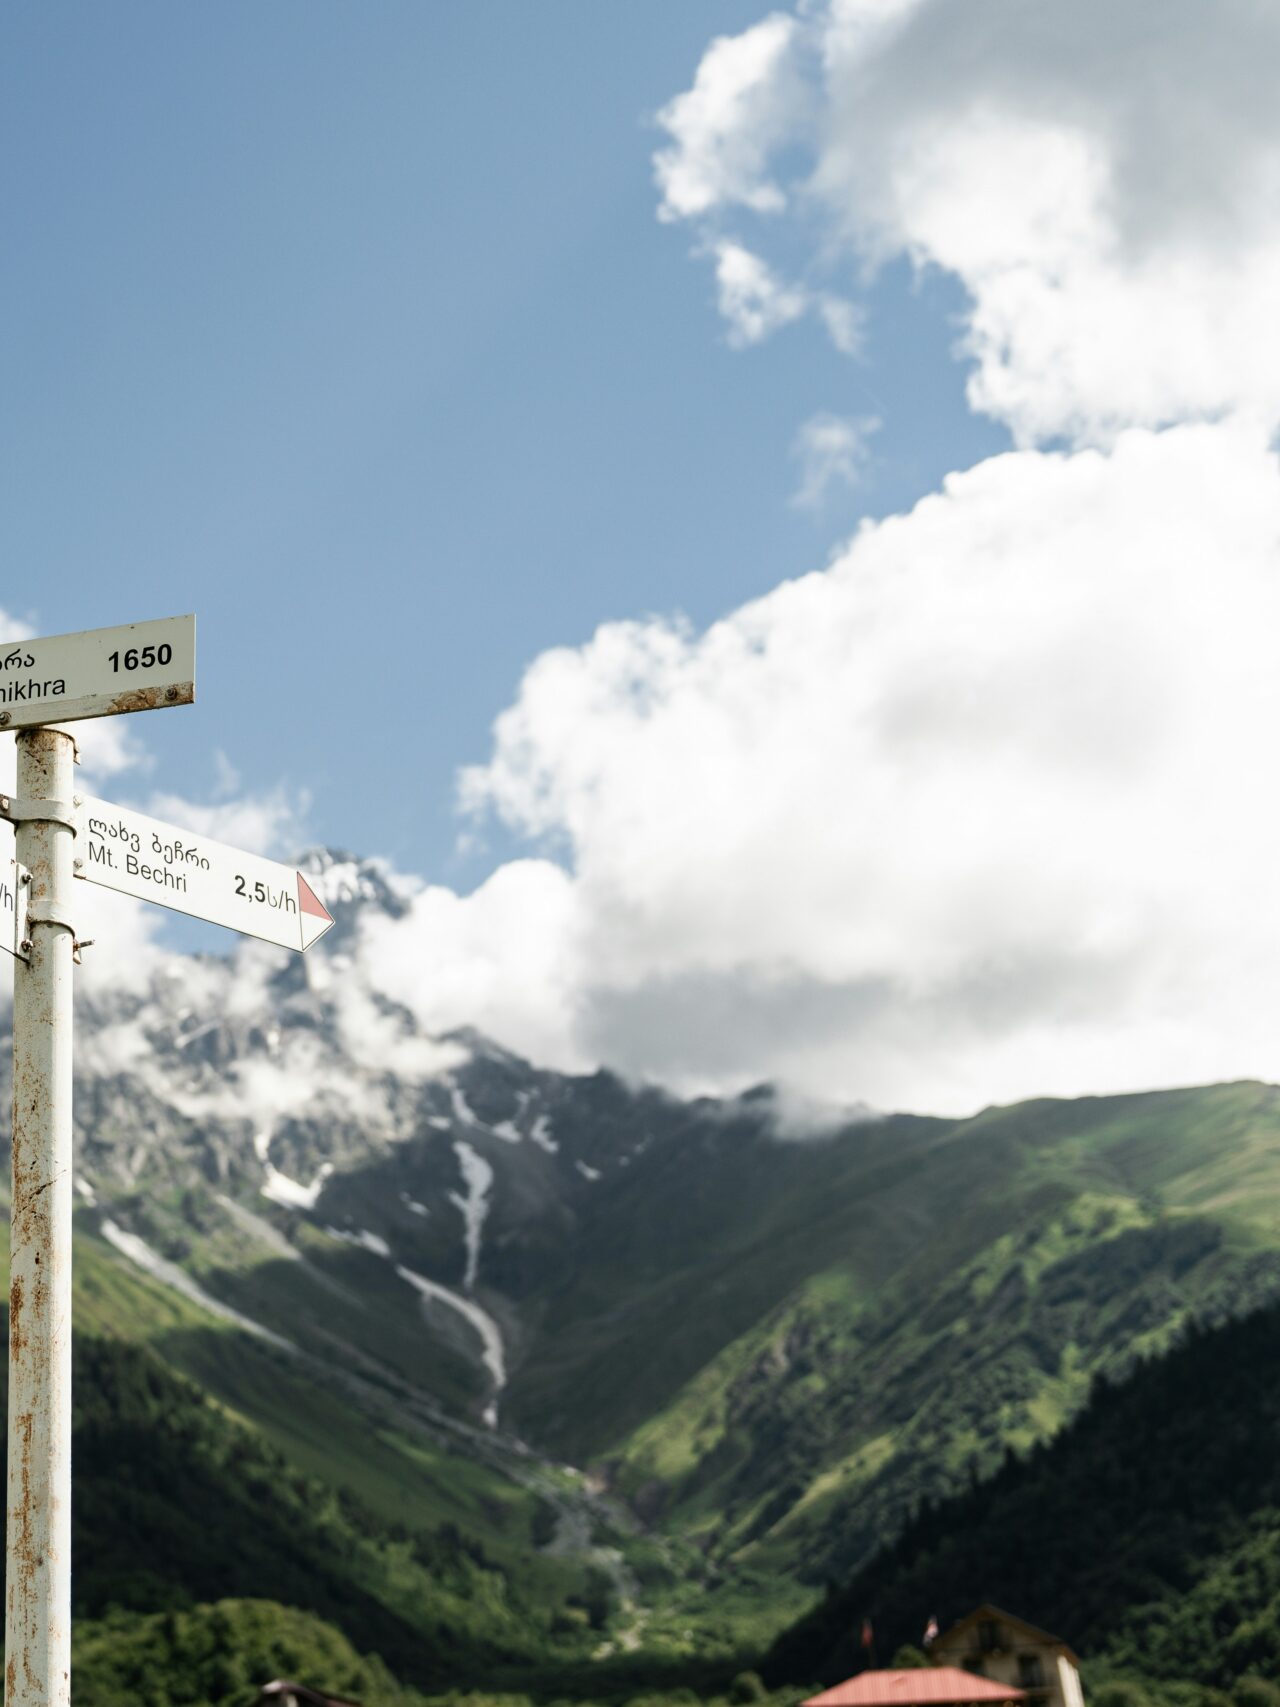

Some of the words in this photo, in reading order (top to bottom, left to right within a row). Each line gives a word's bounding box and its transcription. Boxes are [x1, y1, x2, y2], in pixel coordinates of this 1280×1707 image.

[108, 643, 173, 673] 1650
[88, 841, 119, 870] Mt.
[126, 853, 187, 893] Bechri
